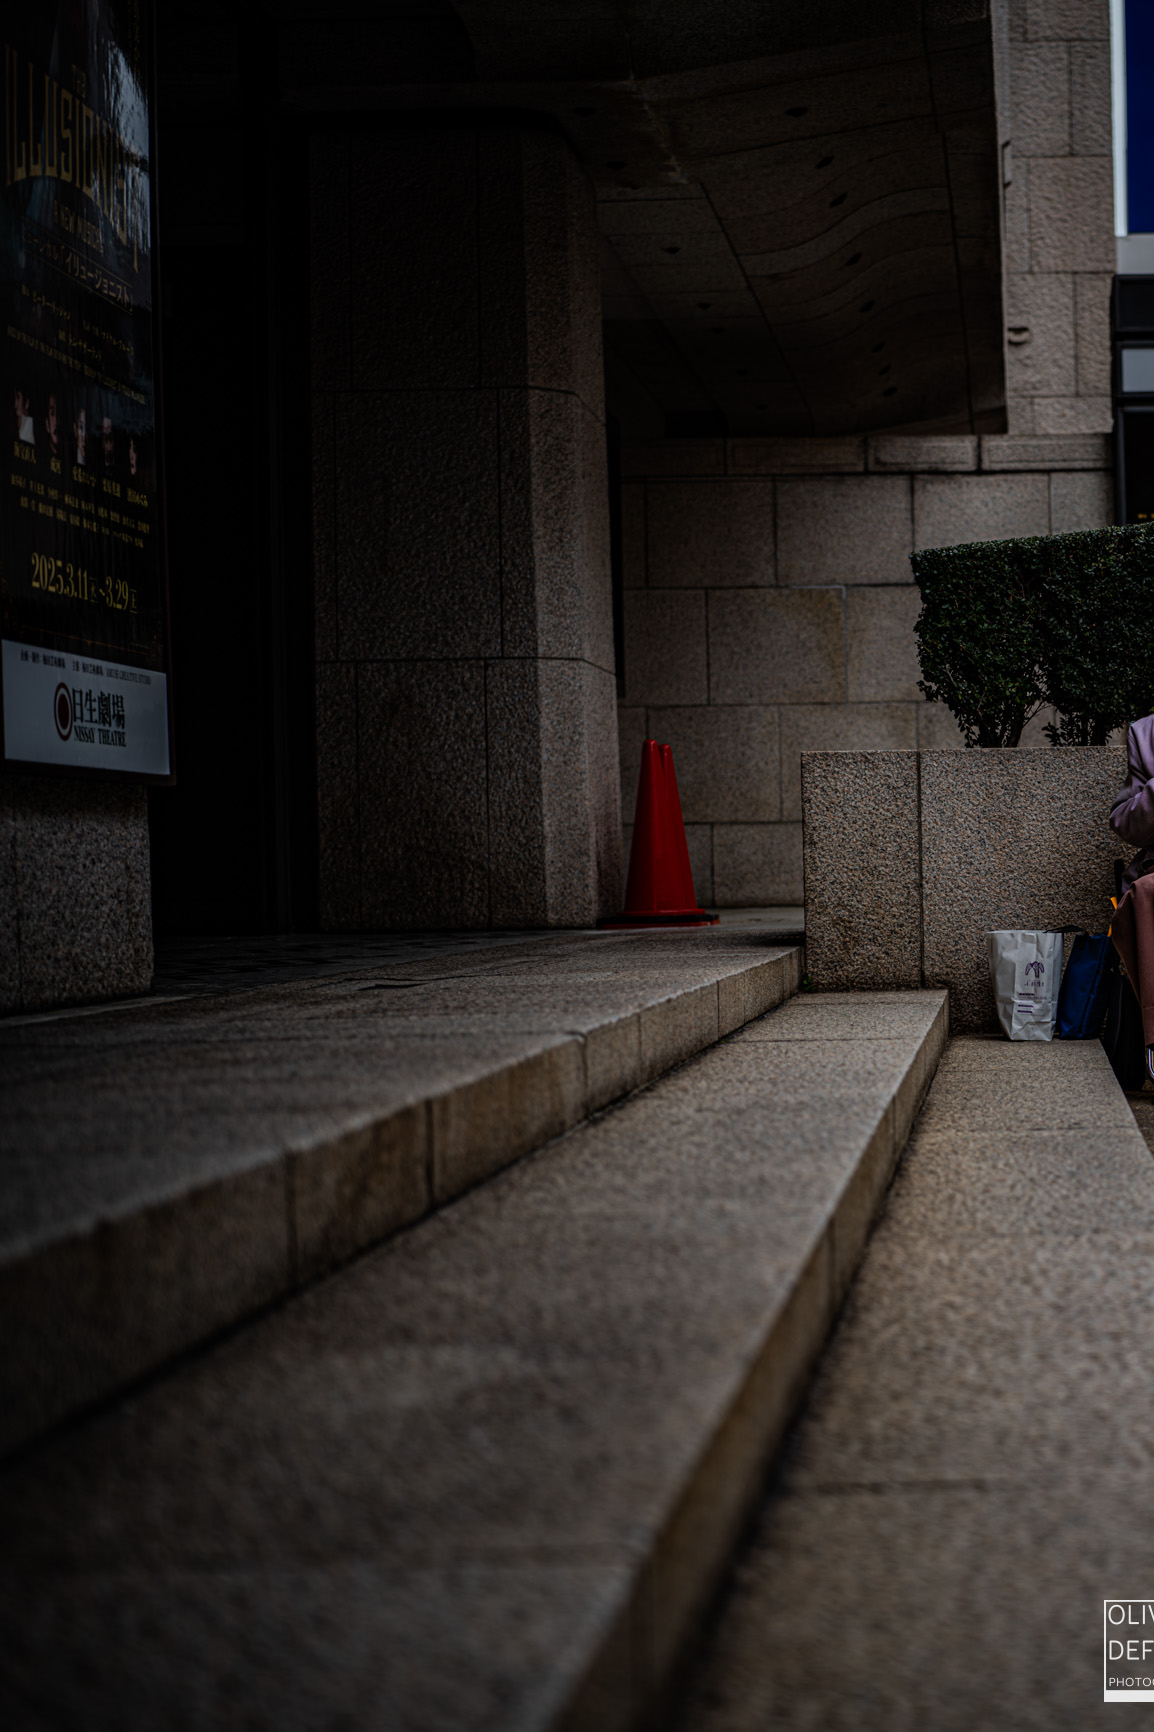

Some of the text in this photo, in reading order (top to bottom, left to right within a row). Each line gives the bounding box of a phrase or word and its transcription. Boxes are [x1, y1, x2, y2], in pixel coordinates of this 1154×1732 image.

[72, 688, 125, 729] 日生劇場
[74, 725, 126, 747] NISSAY THEATRE
